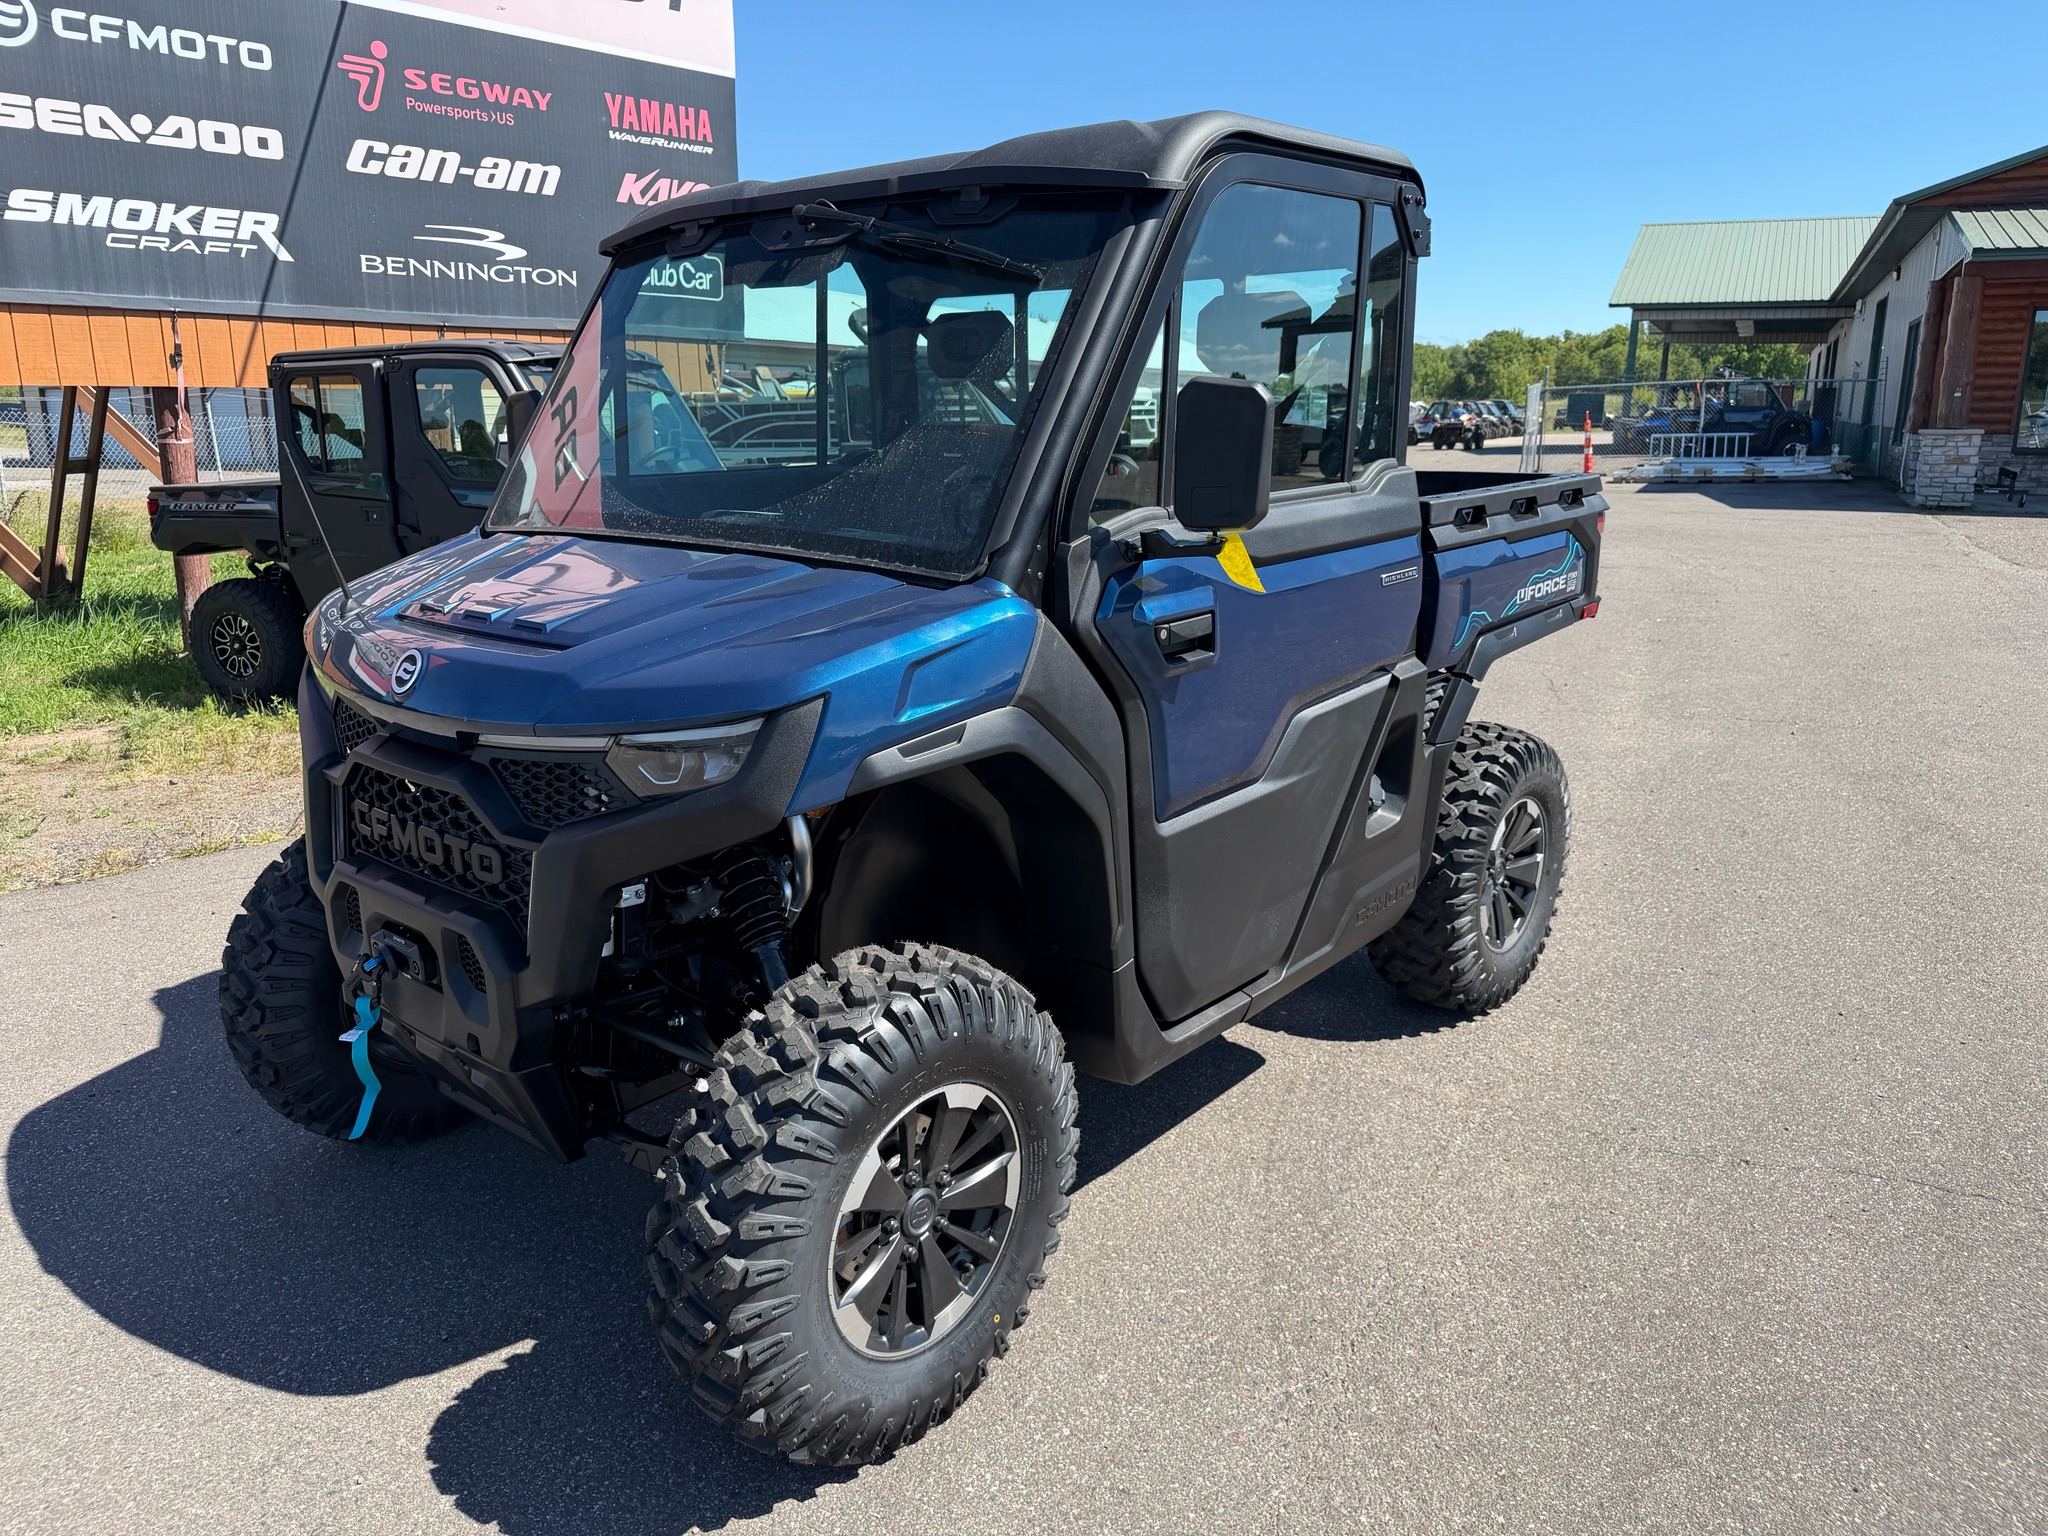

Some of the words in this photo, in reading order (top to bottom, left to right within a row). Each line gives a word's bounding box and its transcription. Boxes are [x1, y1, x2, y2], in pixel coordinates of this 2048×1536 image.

[51, 7, 273, 71] CFMOTO
[404, 68, 552, 111] SEGWAY
[604, 92, 713, 143] YAMAHA
[346, 138, 561, 196] can-am
[616, 168, 711, 206] KAY
[3, 188, 295, 262] SMOKER
[105, 232, 258, 258] CRAFT
[358, 254, 577, 287] BENNINGTON
[679, 261, 713, 290] Car
[170, 501, 237, 511] RANGER
[354, 798, 503, 885] CFMOTO
[1355, 875, 1417, 926] CFMOTO
